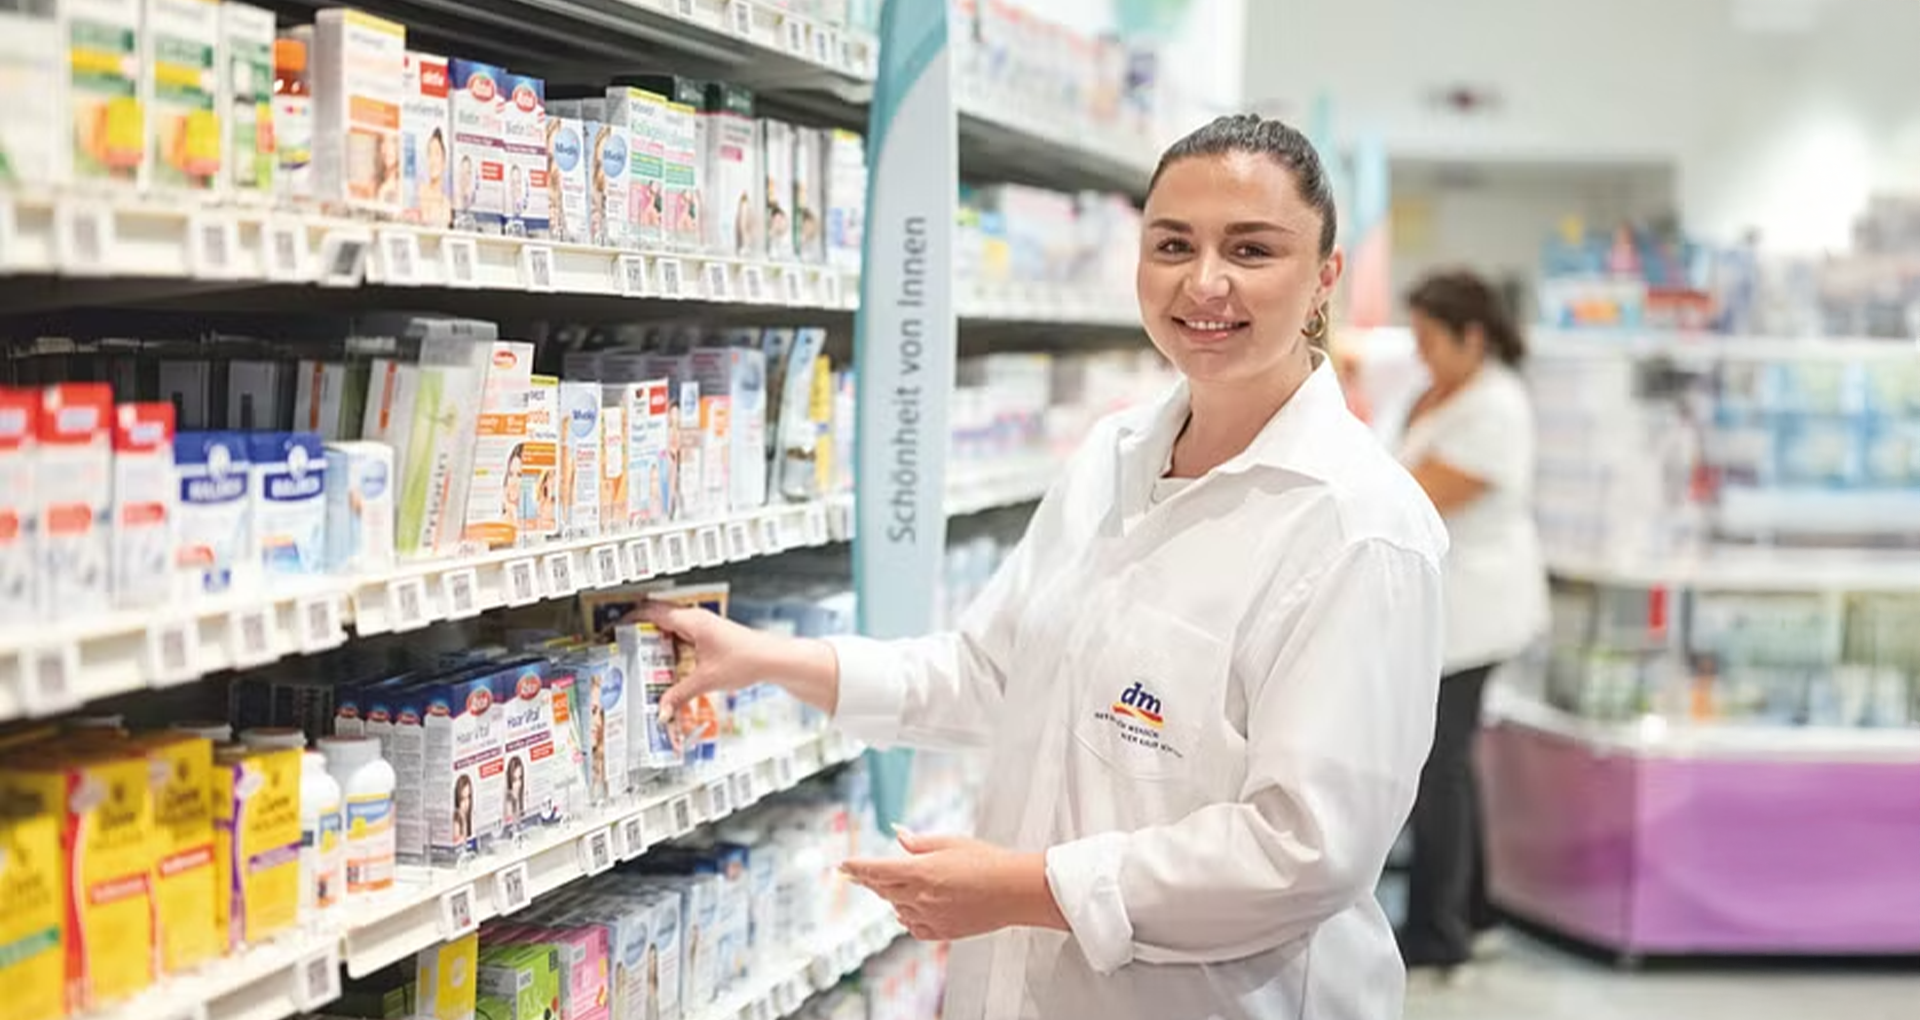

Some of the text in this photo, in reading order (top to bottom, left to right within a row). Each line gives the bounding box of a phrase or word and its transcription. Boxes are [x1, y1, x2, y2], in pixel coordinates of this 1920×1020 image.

[887, 215, 927, 545] Schönheit von Innen
[1121, 681, 1162, 714] dm
